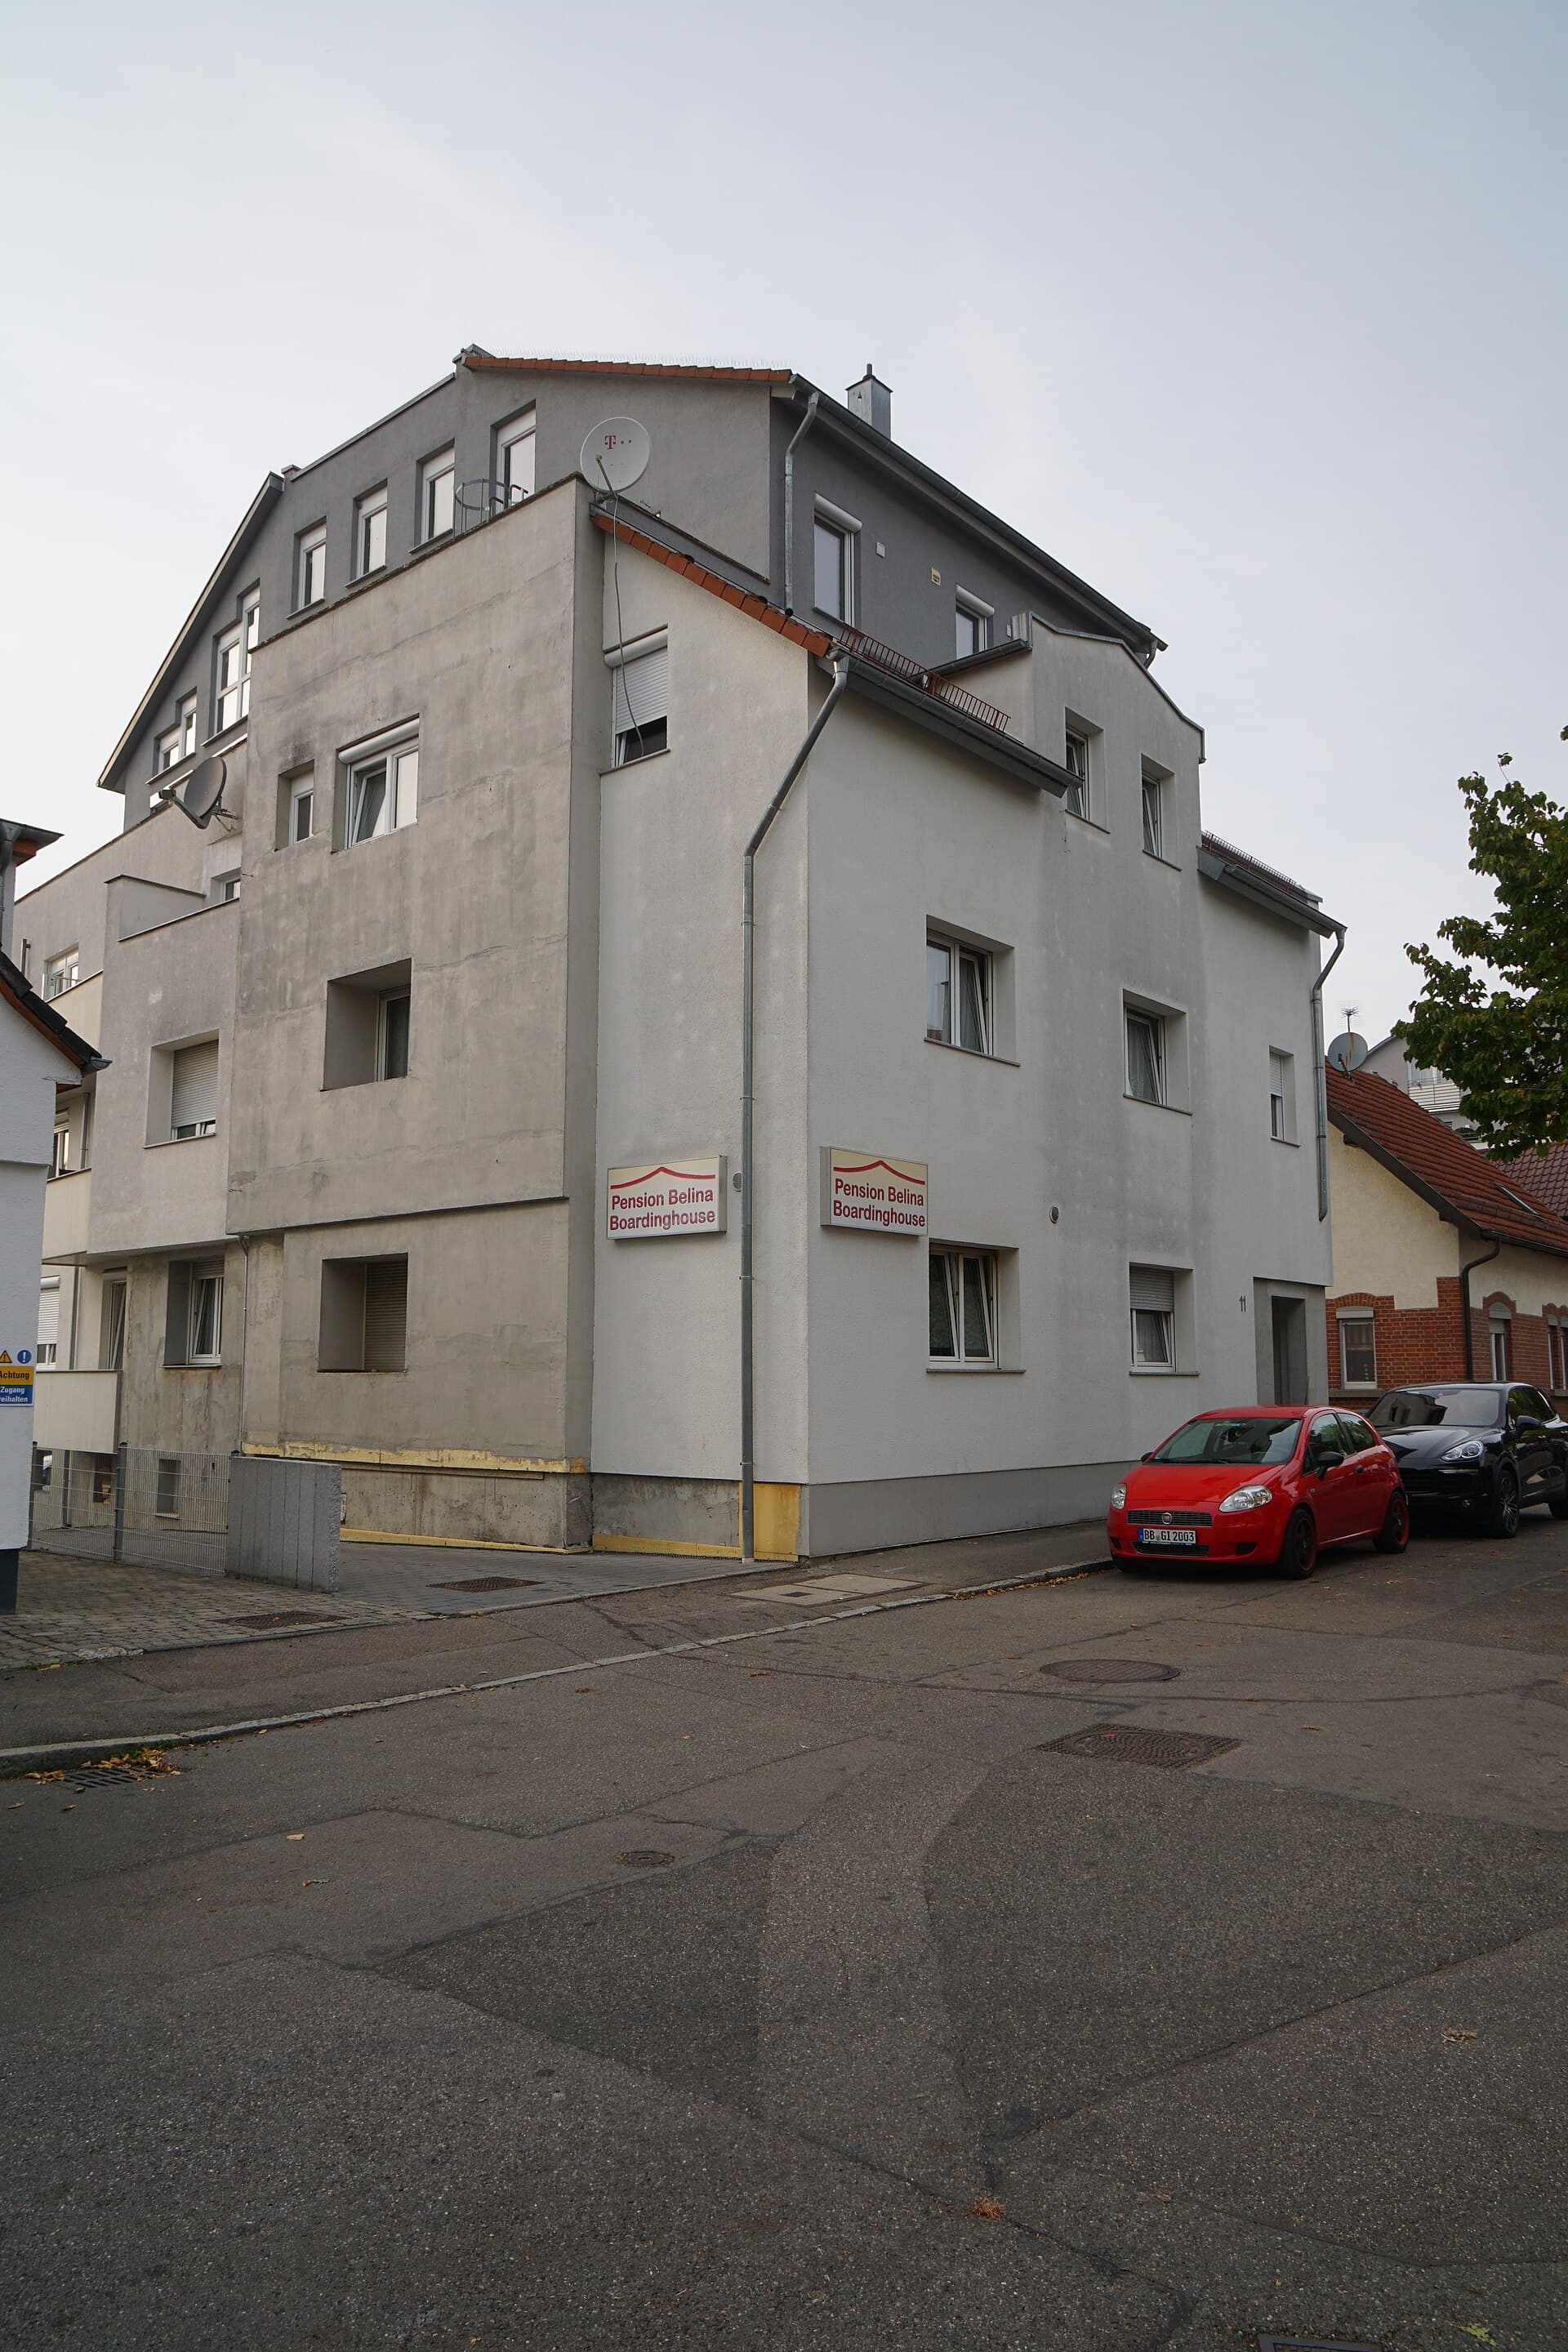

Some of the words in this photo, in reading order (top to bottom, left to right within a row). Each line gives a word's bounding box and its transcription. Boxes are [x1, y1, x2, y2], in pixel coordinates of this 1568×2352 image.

[612, 1192, 664, 1209] Pension
[668, 1187, 713, 1205] Belina
[835, 1178, 884, 1200] Pension
[888, 1186, 924, 1206] Belina
[609, 1209, 715, 1231] Boardinghouse
[833, 1200, 925, 1227] Boardinghouse
[1239, 1295, 1246, 1312] 11
[0, 1386, 25, 1395] Zugang
[1144, 1530, 1155, 1540] BB
[1173, 1531, 1194, 1542] 2003
